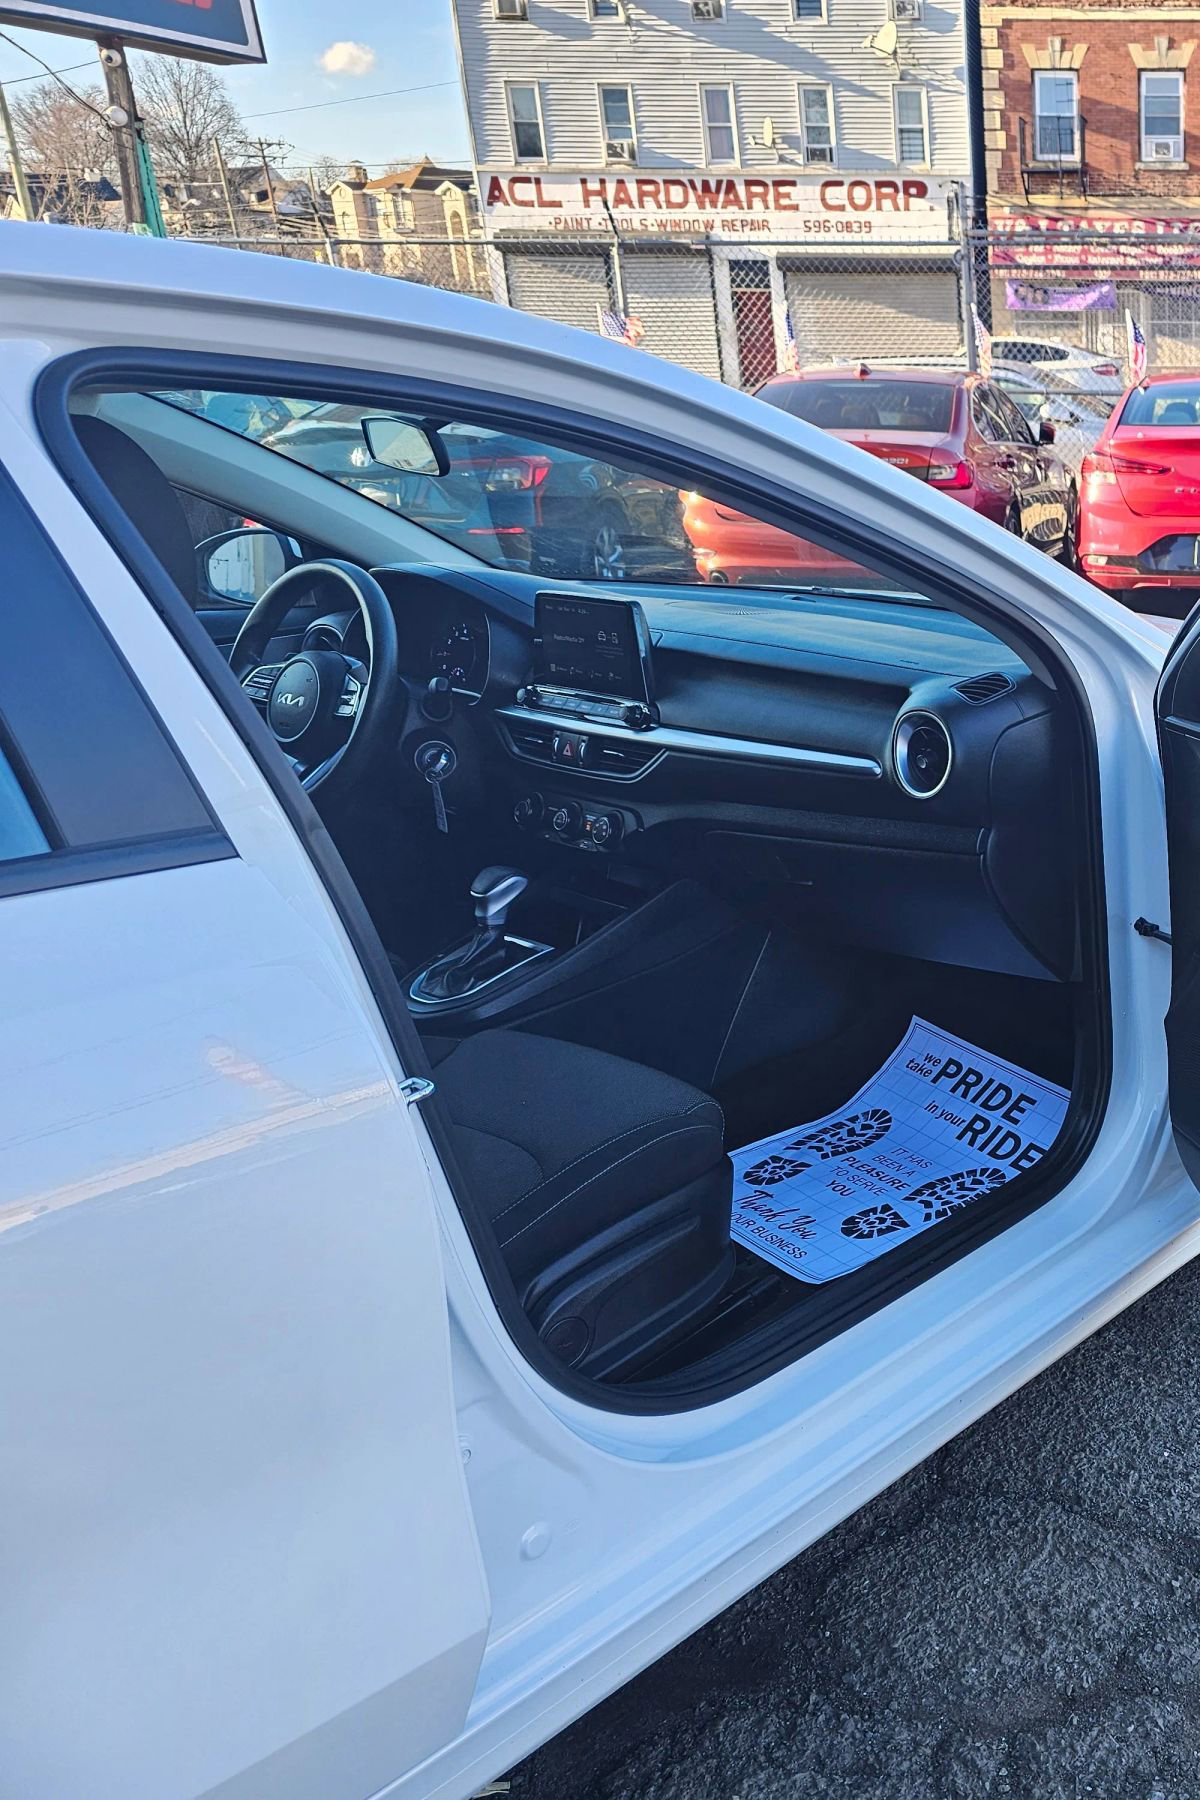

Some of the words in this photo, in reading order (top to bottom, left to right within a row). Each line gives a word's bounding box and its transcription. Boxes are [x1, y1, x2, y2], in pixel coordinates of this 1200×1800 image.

[487, 176, 563, 208] ACL
[579, 177, 800, 212] HARDWARE
[722, 219, 772, 233] REPAIR
[905, 1058, 933, 1077] take
[924, 1053, 941, 1067] we
[930, 1057, 1037, 1126] PRIDE
[924, 1100, 938, 1113] in
[935, 1109, 966, 1127] your
[955, 1113, 1048, 1173] RIDE
[872, 1155, 906, 1172] BEEN
[902, 1170, 916, 1178] A
[891, 1147, 909, 1156] IT
[907, 1154, 932, 1169] HAS
[825, 1180, 856, 1197] YOU
[830, 1166, 849, 1177] TO
[847, 1175, 888, 1196] SERVE
[841, 1156, 911, 1191] PLEASURE
[734, 1190, 800, 1222] Thank
[778, 1215, 816, 1239] You
[731, 1212, 756, 1228] OUR
[751, 1225, 807, 1259] BUSINESS
